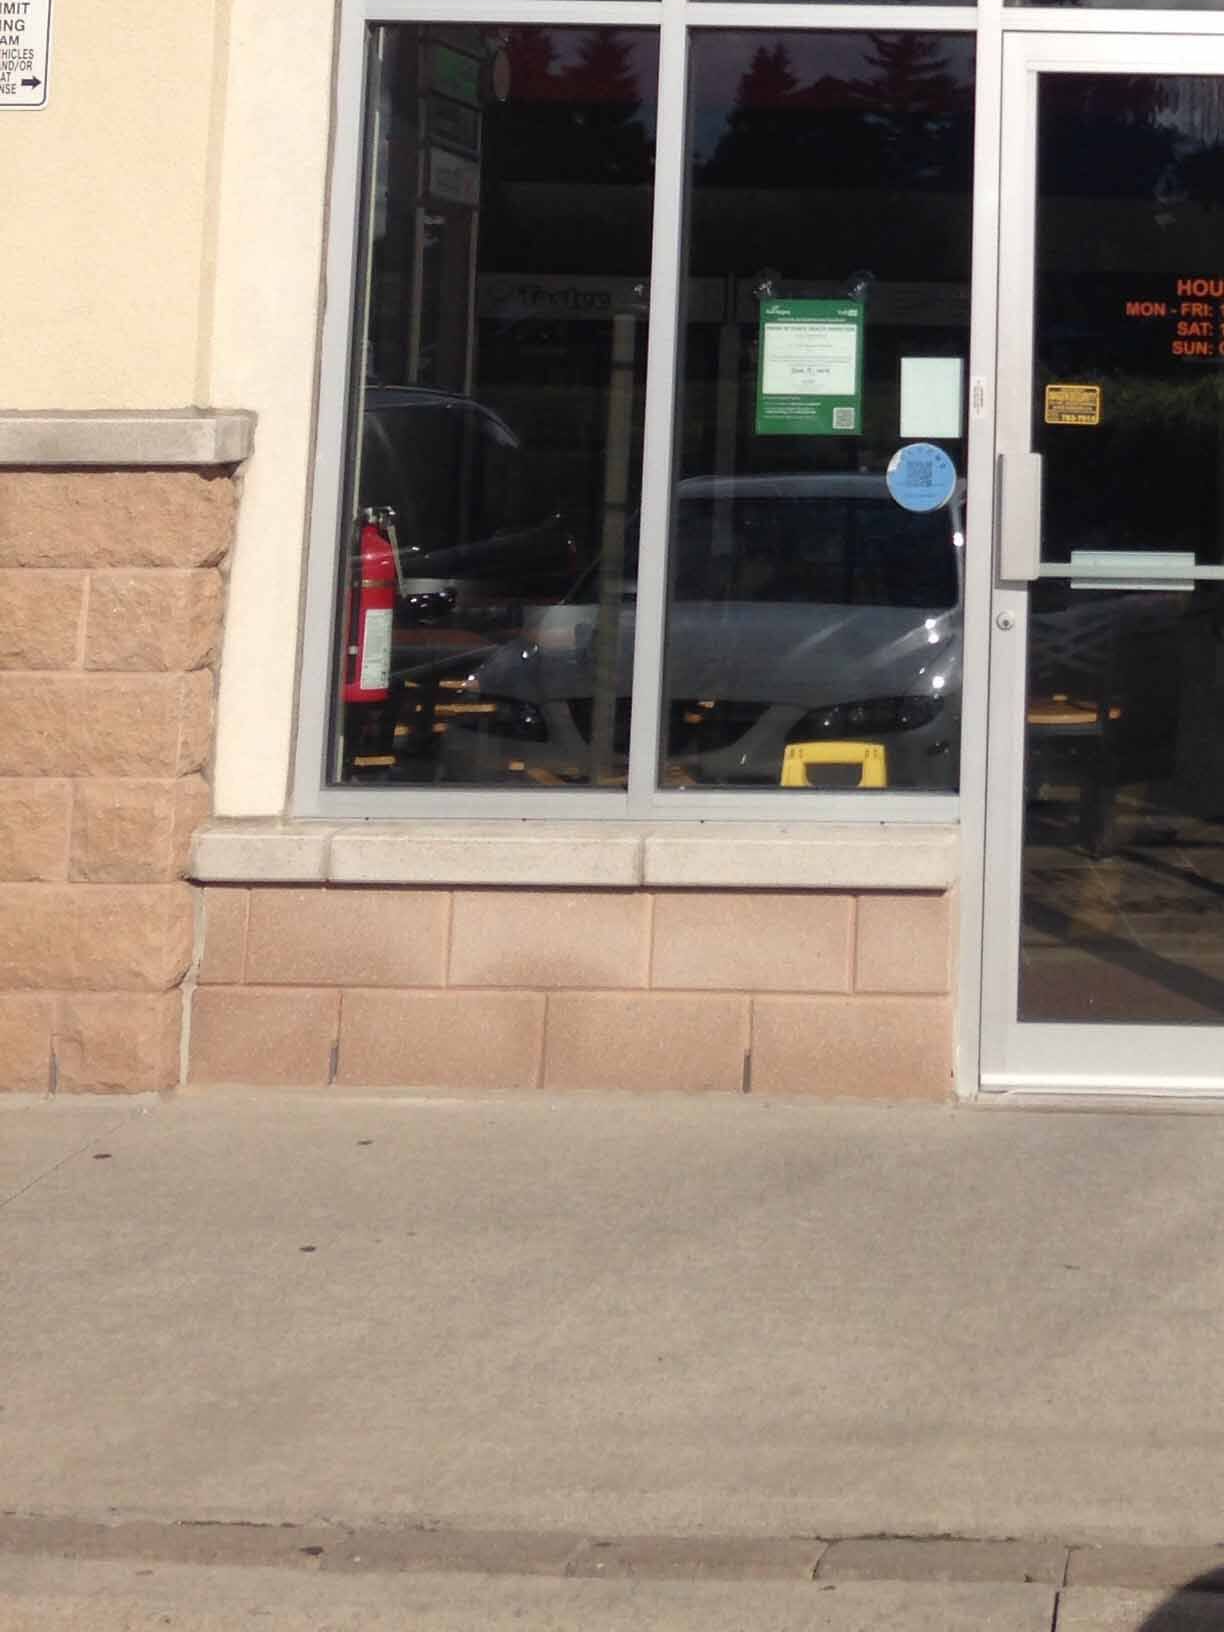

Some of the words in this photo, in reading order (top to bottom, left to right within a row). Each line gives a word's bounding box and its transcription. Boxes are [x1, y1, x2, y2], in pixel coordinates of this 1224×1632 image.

[0, 48, 34, 59] HICLES
[0, 60, 33, 71] ND/OR
[1126, 302, 1166, 316] MON
[1181, 303, 1213, 317] FRI:
[1177, 321, 1213, 336] SAT:
[1172, 341, 1213, 355] SUN:
